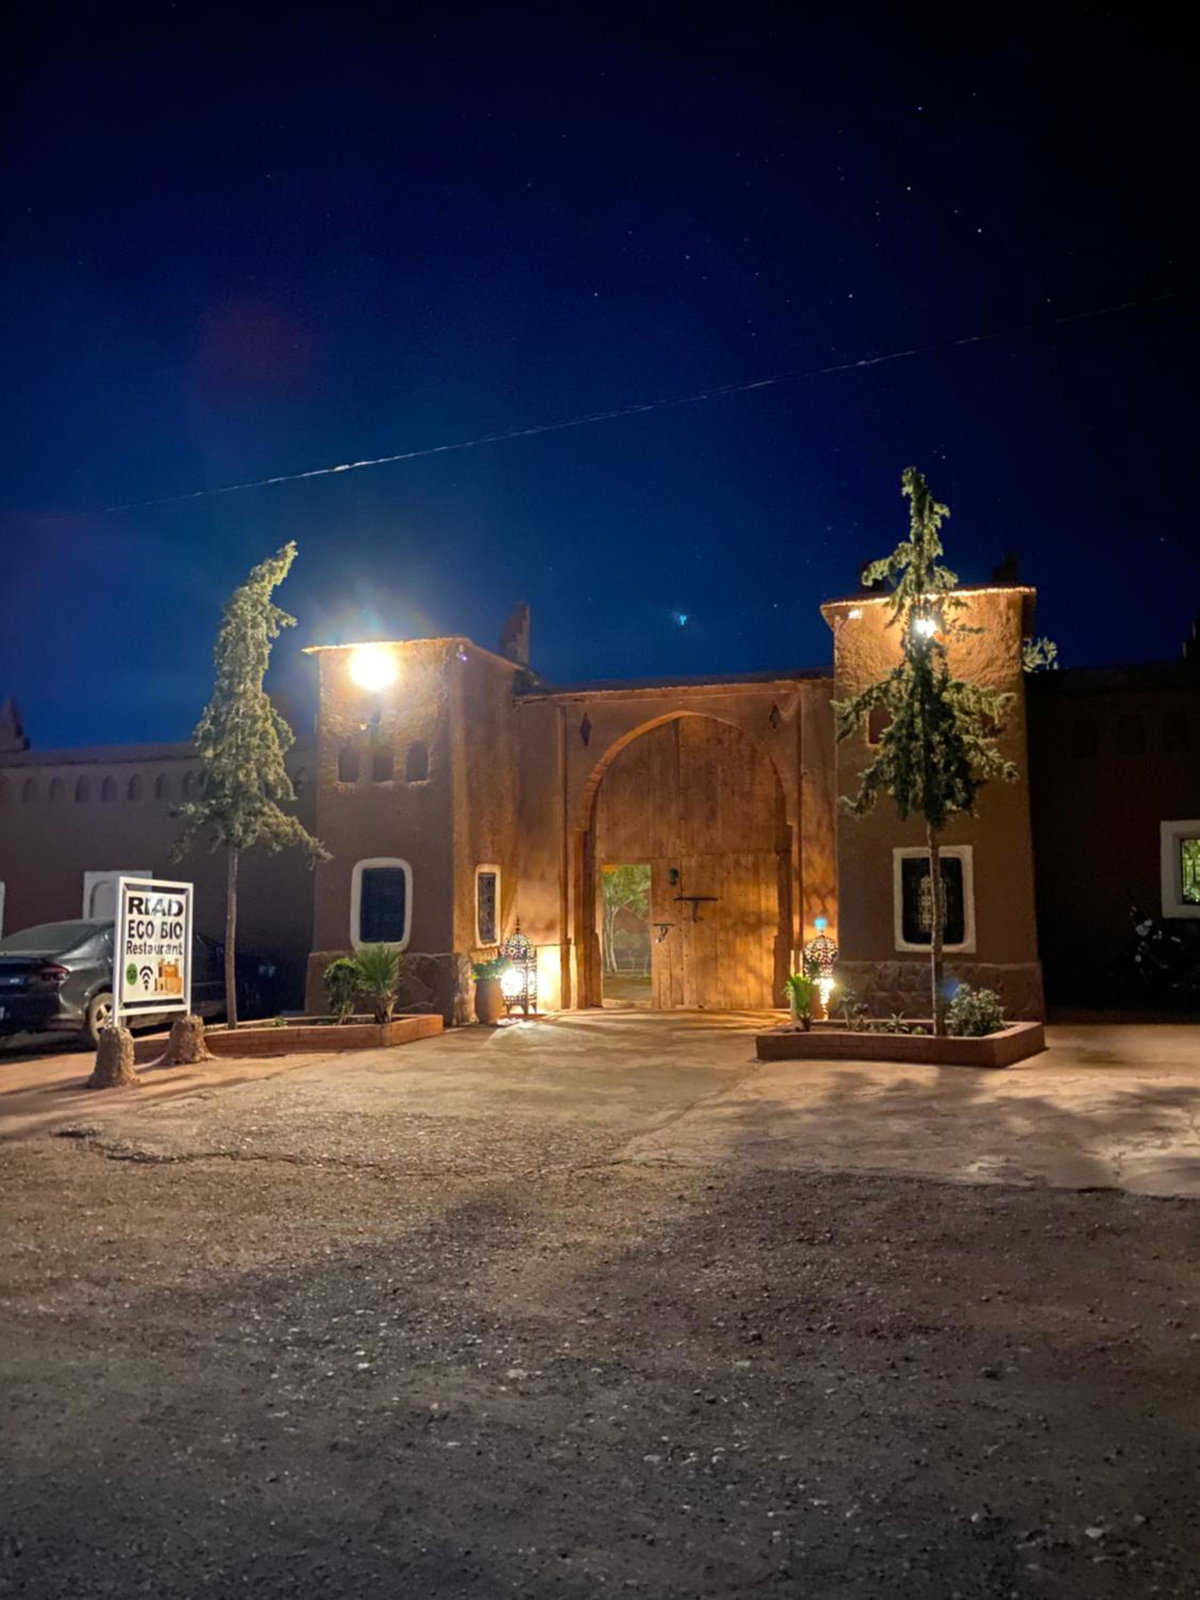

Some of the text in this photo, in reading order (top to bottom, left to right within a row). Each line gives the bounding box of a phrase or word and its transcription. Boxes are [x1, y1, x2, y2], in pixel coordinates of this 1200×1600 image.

[128, 896, 184, 917] RIAD
[128, 919, 183, 940] ECO BIO
[126, 940, 183, 955] Restaurant
